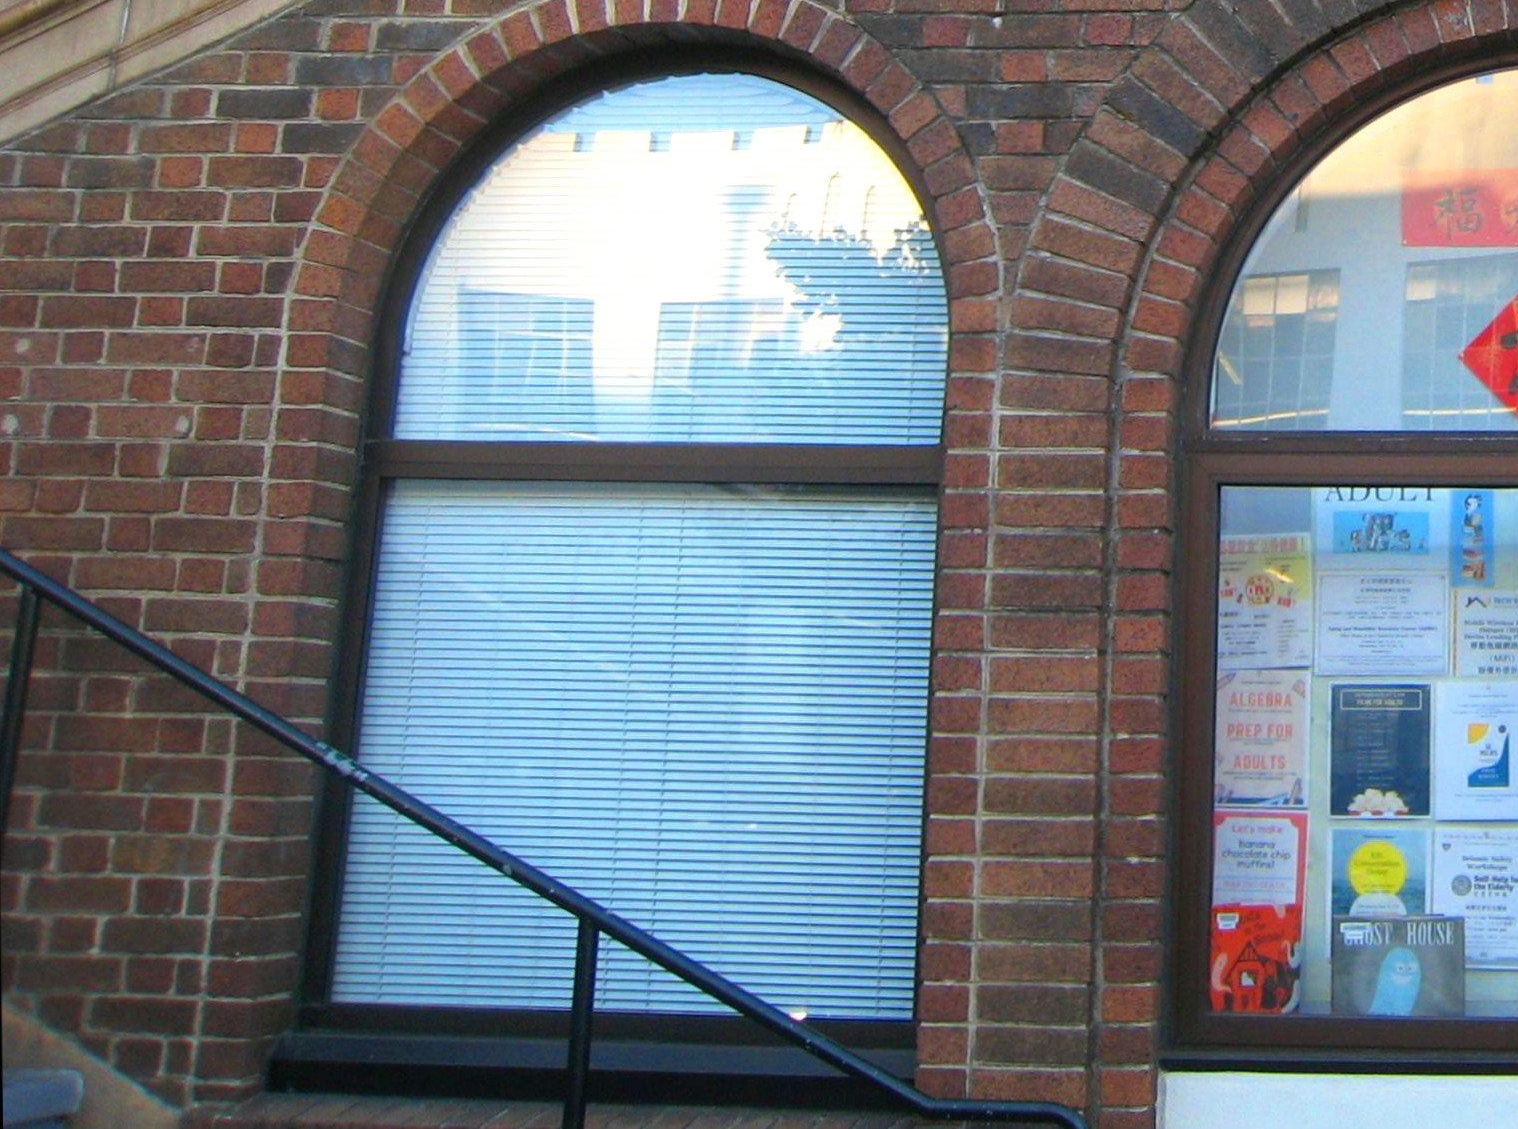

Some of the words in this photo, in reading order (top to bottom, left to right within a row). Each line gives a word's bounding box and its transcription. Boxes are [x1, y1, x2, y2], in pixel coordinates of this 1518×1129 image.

[1229, 692, 1293, 708] ALGEBRA
[1226, 723, 1262, 739] PREP
[1267, 723, 1294, 739] FOR
[1233, 754, 1287, 770] ADULTS
[1257, 826, 1283, 834] make
[1238, 839, 1275, 849] banana
[1222, 849, 1267, 858] chocolate
[1270, 850, 1292, 861] chip
[1488, 883, 1514, 892] Elderly
[1407, 921, 1455, 945] HOUSE
